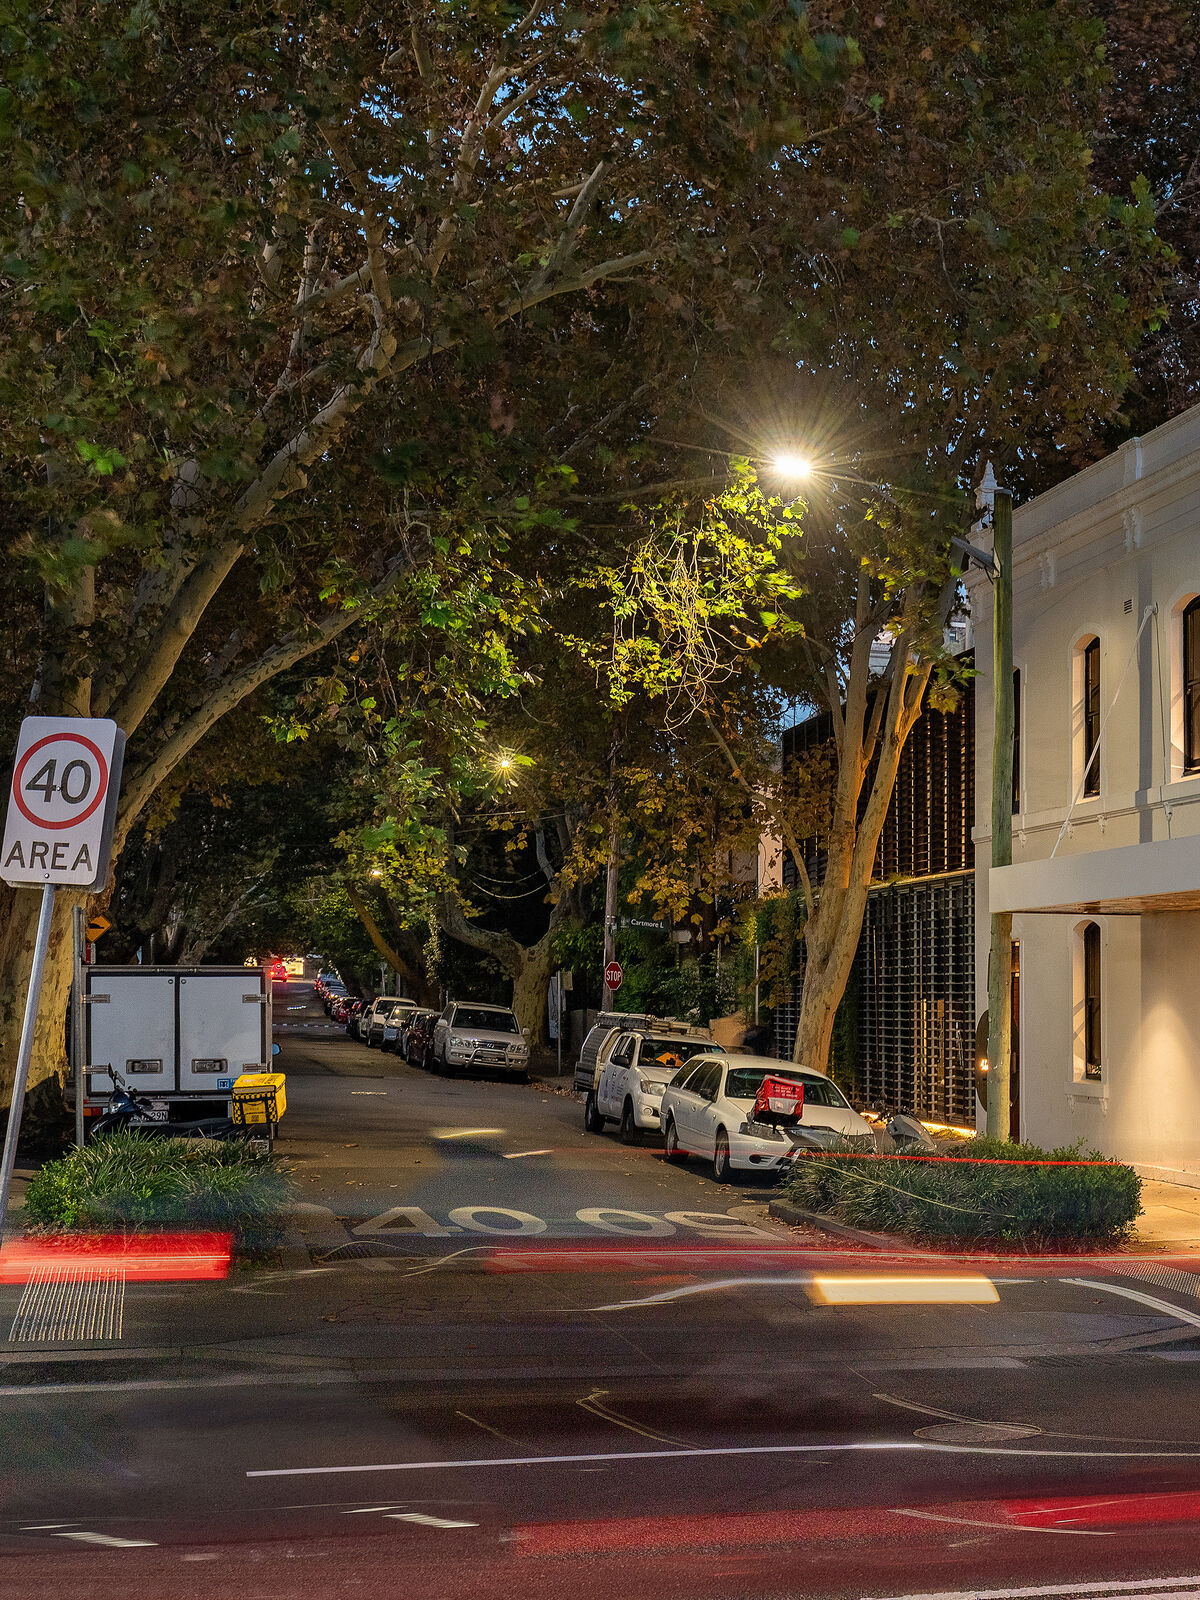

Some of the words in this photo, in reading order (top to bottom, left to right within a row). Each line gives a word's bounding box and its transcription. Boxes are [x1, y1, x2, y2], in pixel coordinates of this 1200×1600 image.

[24, 759, 92, 804] 40
[4, 840, 93, 872] AREA
[631, 918, 659, 928] Cartmore
[606, 970, 622, 982] STOP
[351, 1206, 548, 1237] 40
